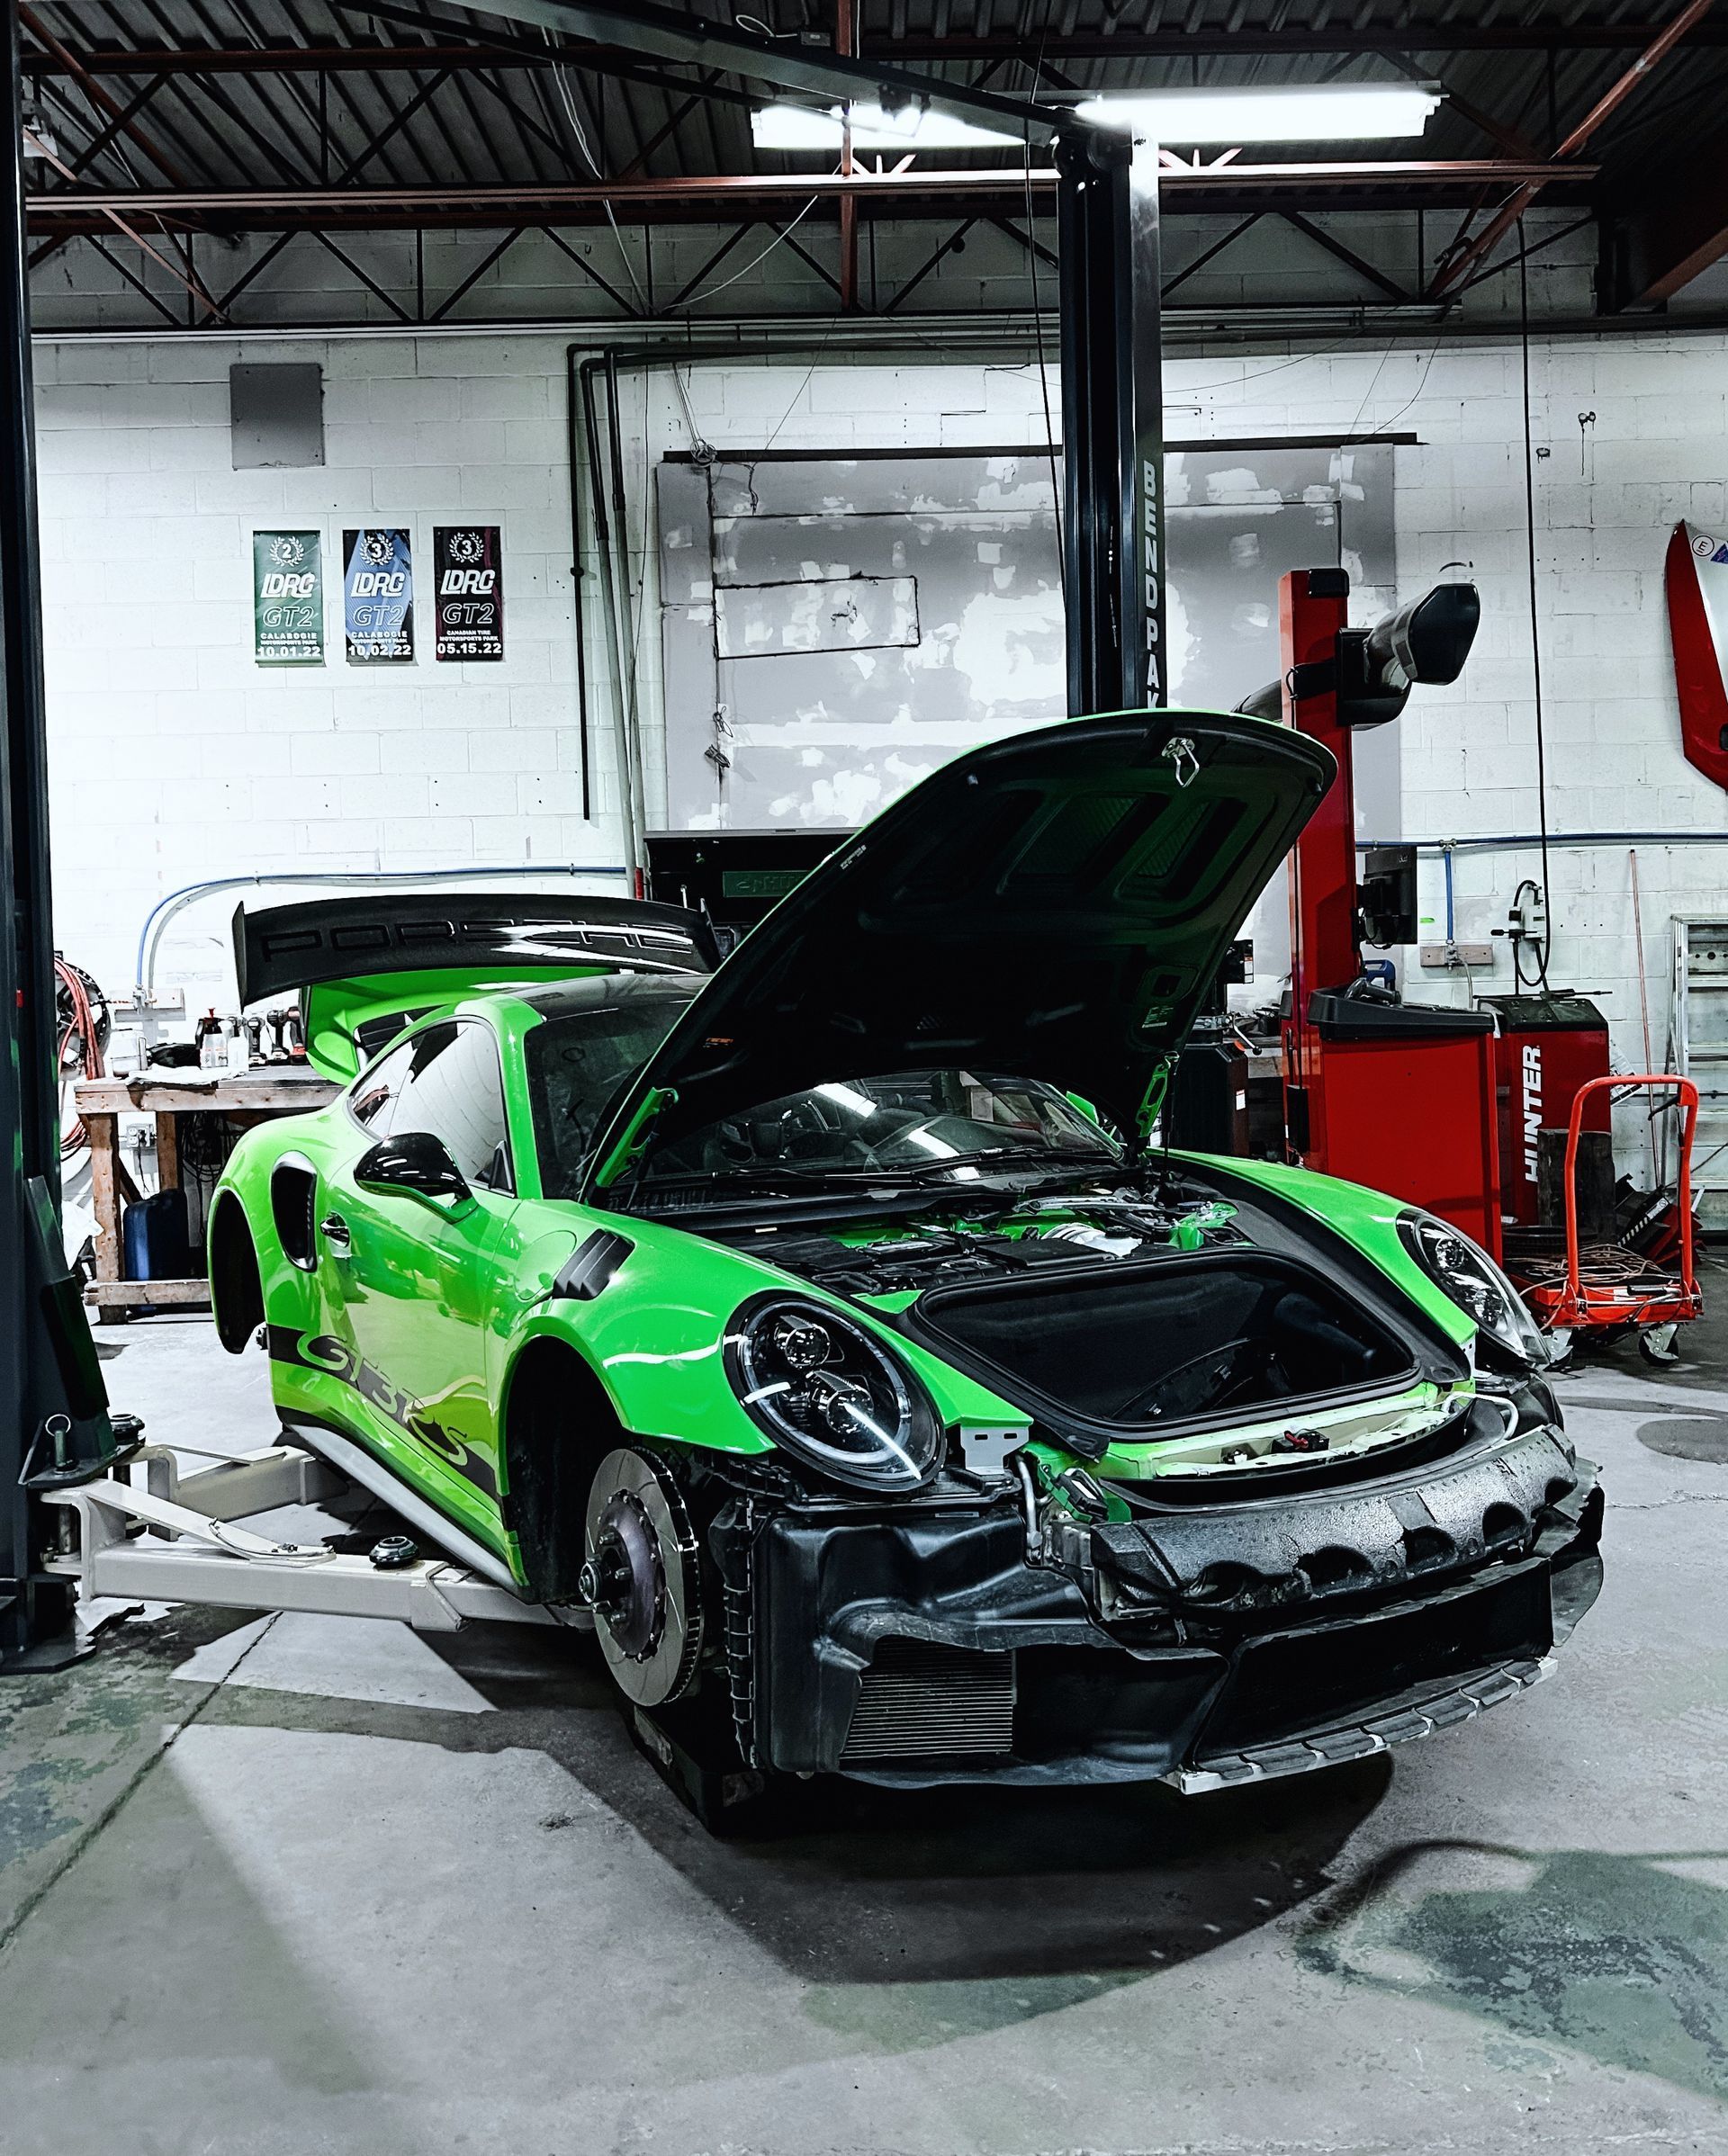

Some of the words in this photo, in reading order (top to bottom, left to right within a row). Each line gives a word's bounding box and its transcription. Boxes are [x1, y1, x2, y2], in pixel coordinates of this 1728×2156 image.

[282, 543, 292, 559] 2
[371, 543, 382, 559] 3
[461, 539, 472, 555] 3
[263, 606, 314, 627] GT2
[353, 605, 404, 626] GT2
[442, 602, 495, 624] GT2
[256, 646, 321, 657] 10.01.22
[347, 644, 411, 656] 10.02.22
[436, 642, 502, 654] 05.15.22
[261, 918, 692, 962] PORSCHE
[1522, 1045, 1543, 1183] HUNTER
